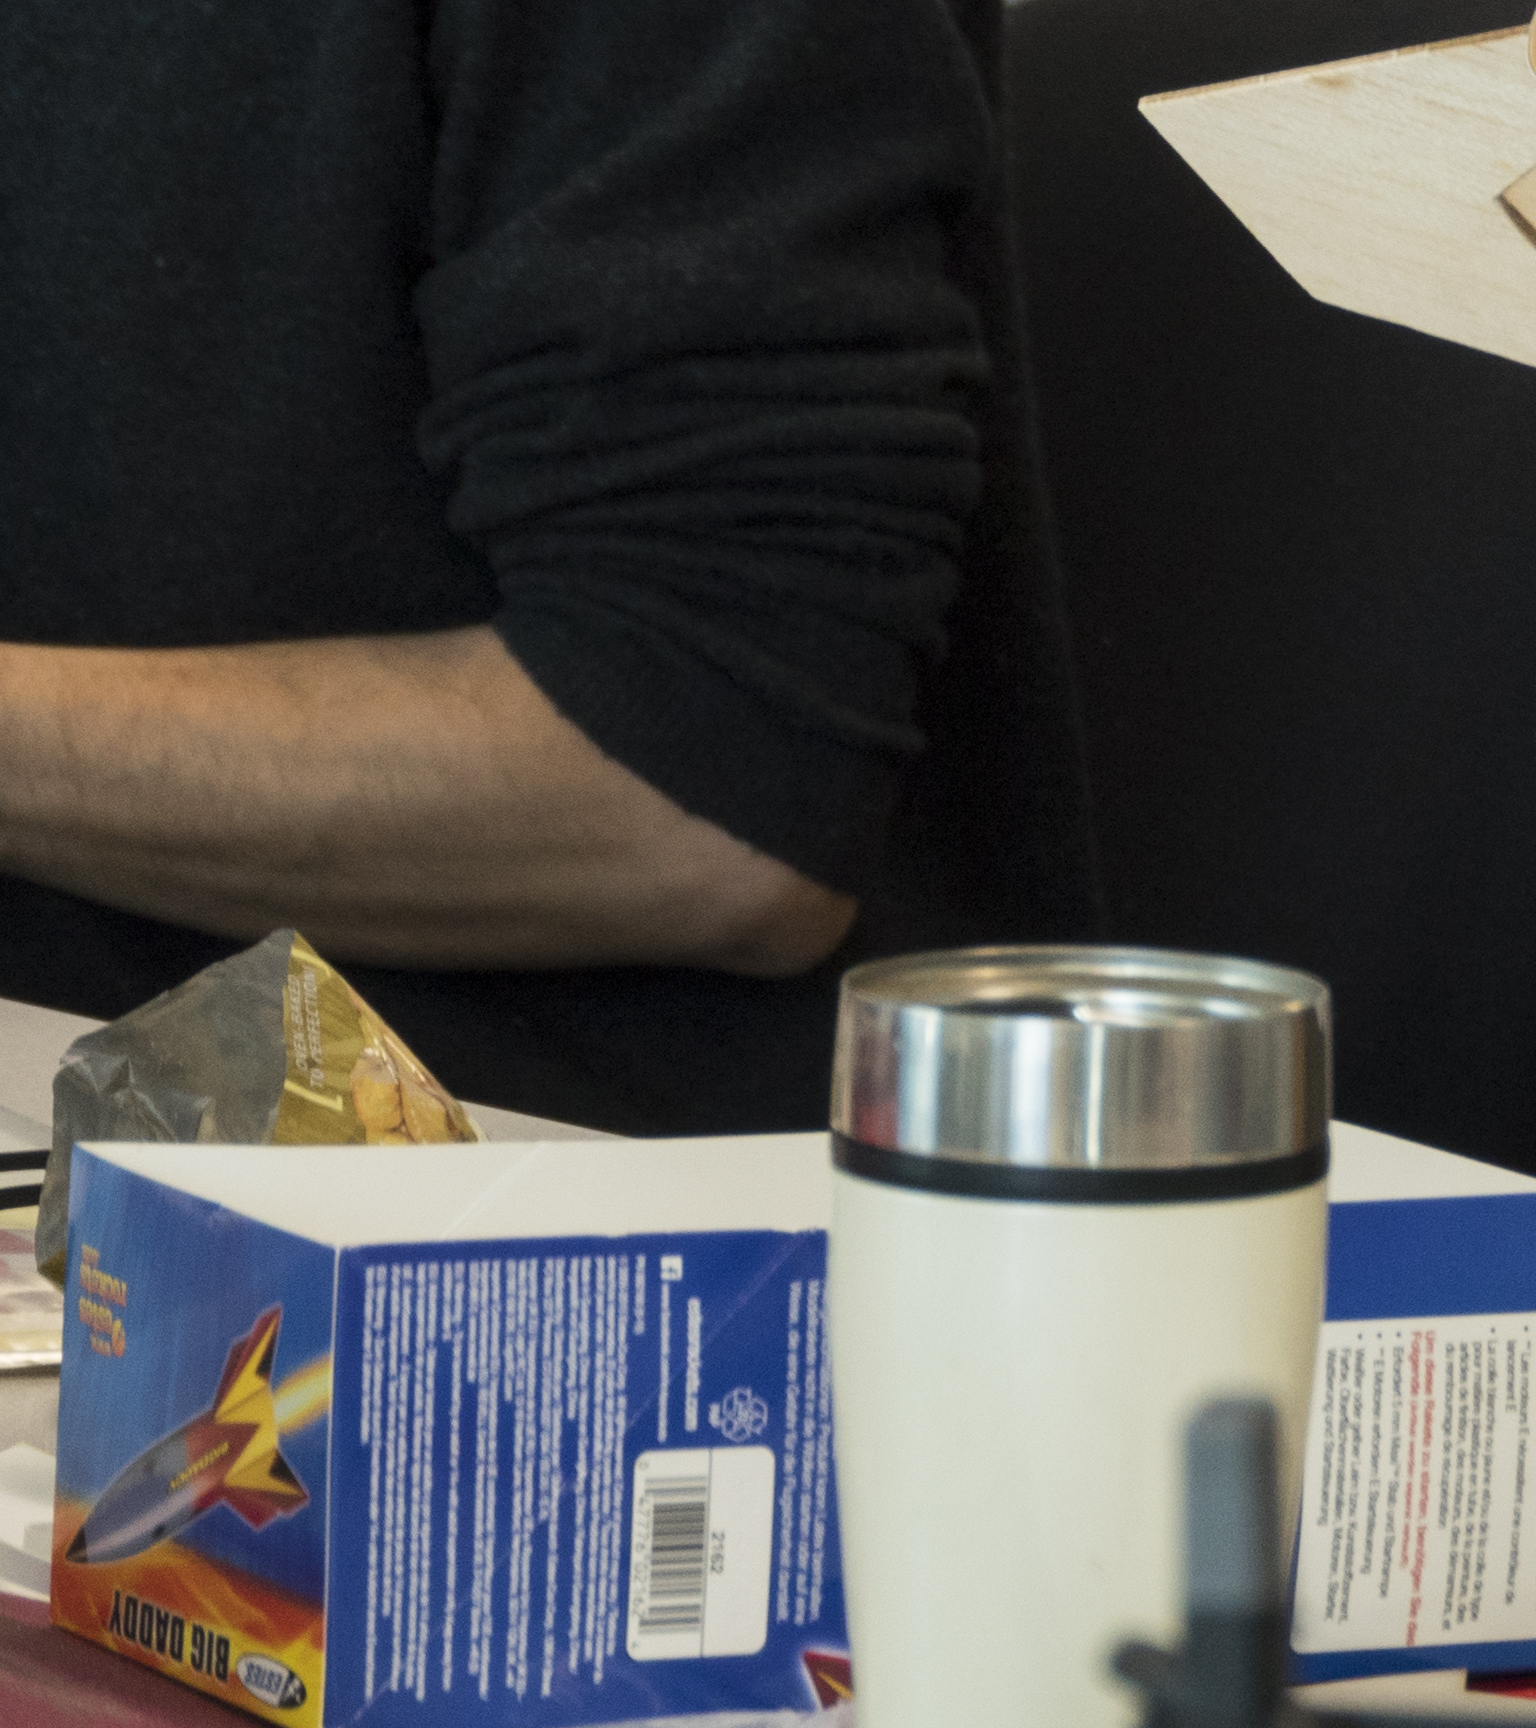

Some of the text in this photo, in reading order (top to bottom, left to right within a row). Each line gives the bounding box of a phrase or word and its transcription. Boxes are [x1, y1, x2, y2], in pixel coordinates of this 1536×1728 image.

[303, 969, 324, 1088] TO PERFECTION
[709, 1530, 726, 1575] 2162
[109, 1589, 230, 1683] BIG DADDY
[244, 1662, 282, 1693] ESTES
